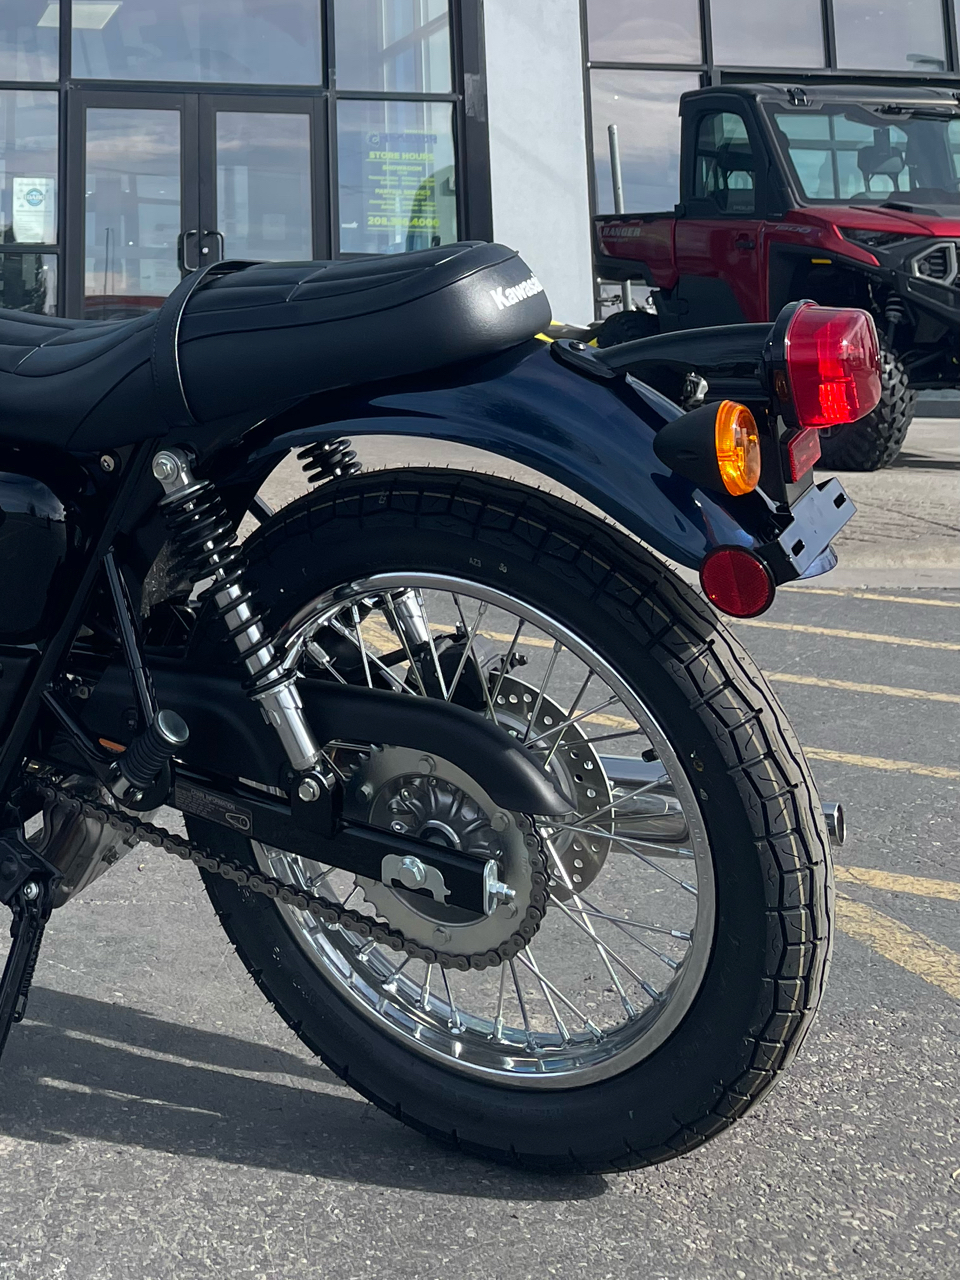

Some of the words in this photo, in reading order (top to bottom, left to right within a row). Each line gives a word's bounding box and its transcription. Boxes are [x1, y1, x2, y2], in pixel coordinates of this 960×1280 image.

[369, 151, 399, 159] STORE
[402, 152, 434, 160] HOURS
[602, 227, 641, 237] RANGER
